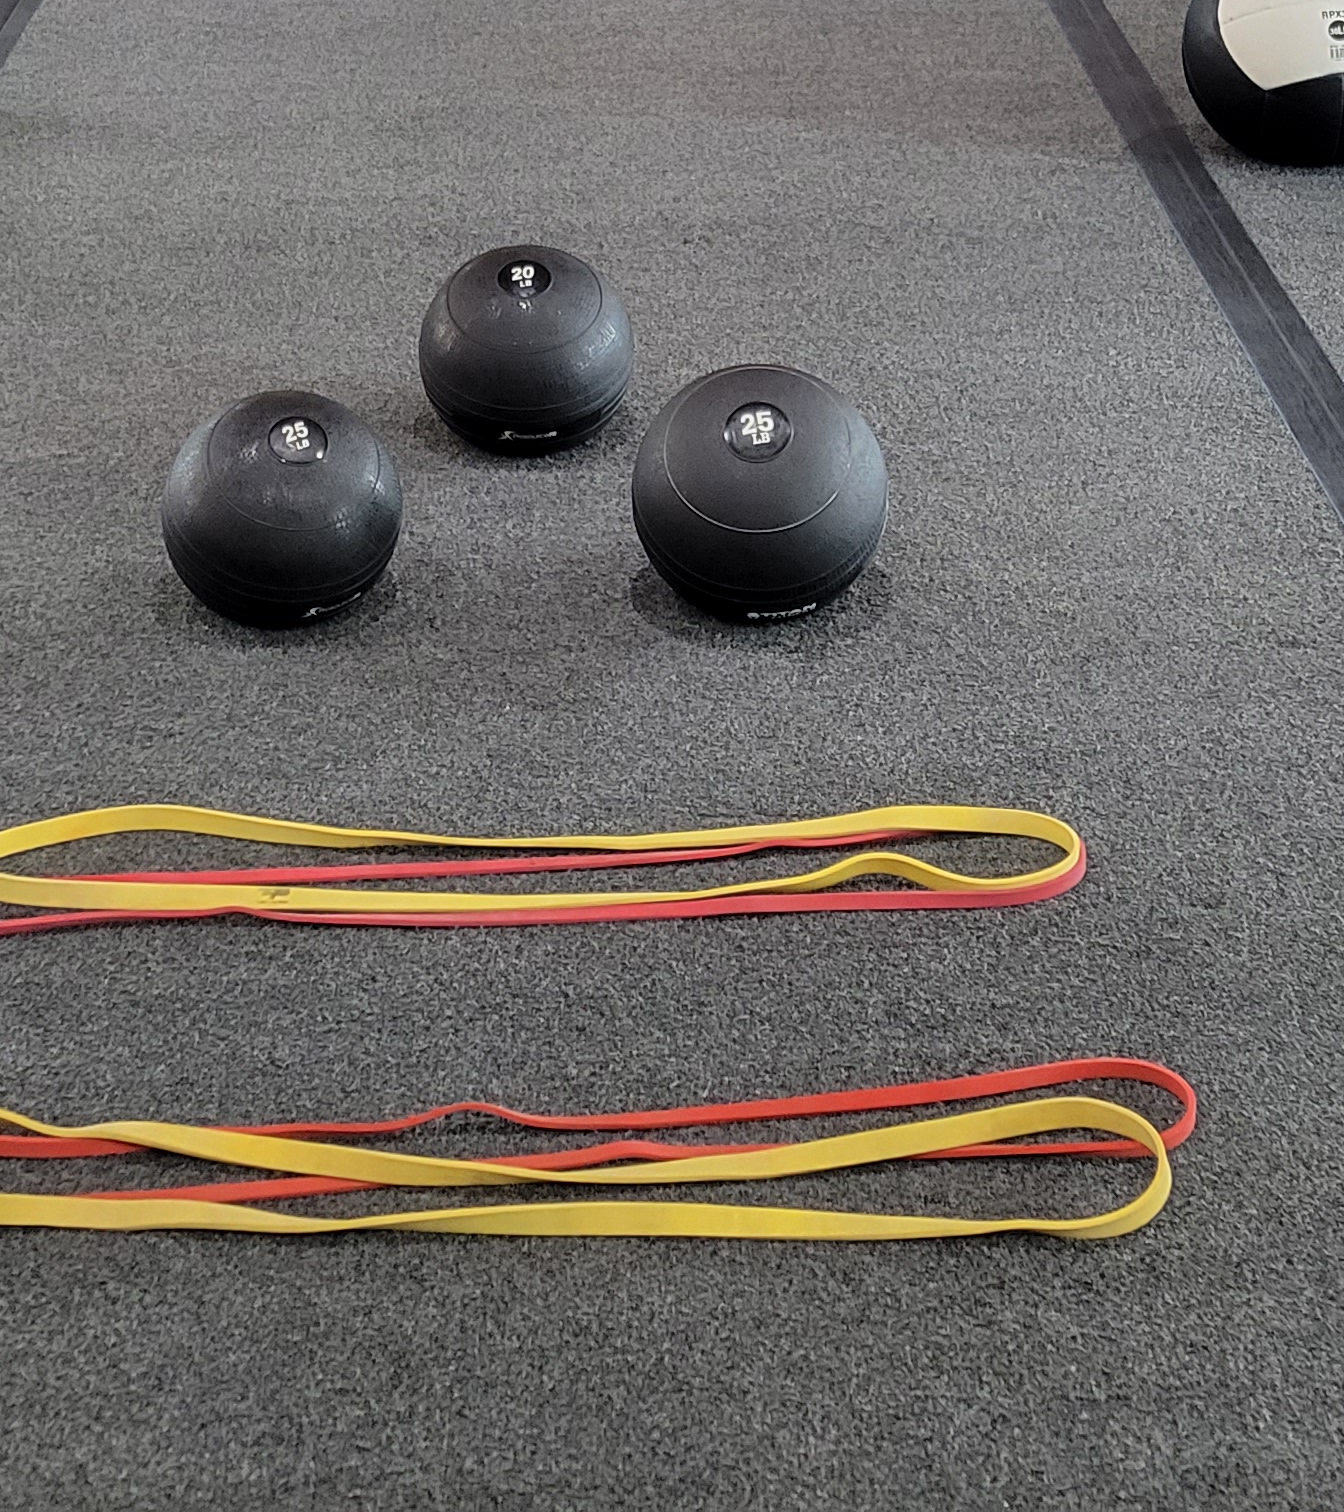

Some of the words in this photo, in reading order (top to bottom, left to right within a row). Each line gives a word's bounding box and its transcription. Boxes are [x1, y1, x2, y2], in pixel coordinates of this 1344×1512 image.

[511, 264, 535, 281] 20
[519, 279, 533, 288] LB
[740, 410, 775, 436] 25
[281, 421, 309, 444] 25
[751, 432, 771, 445] LB
[296, 439, 311, 450] LB
